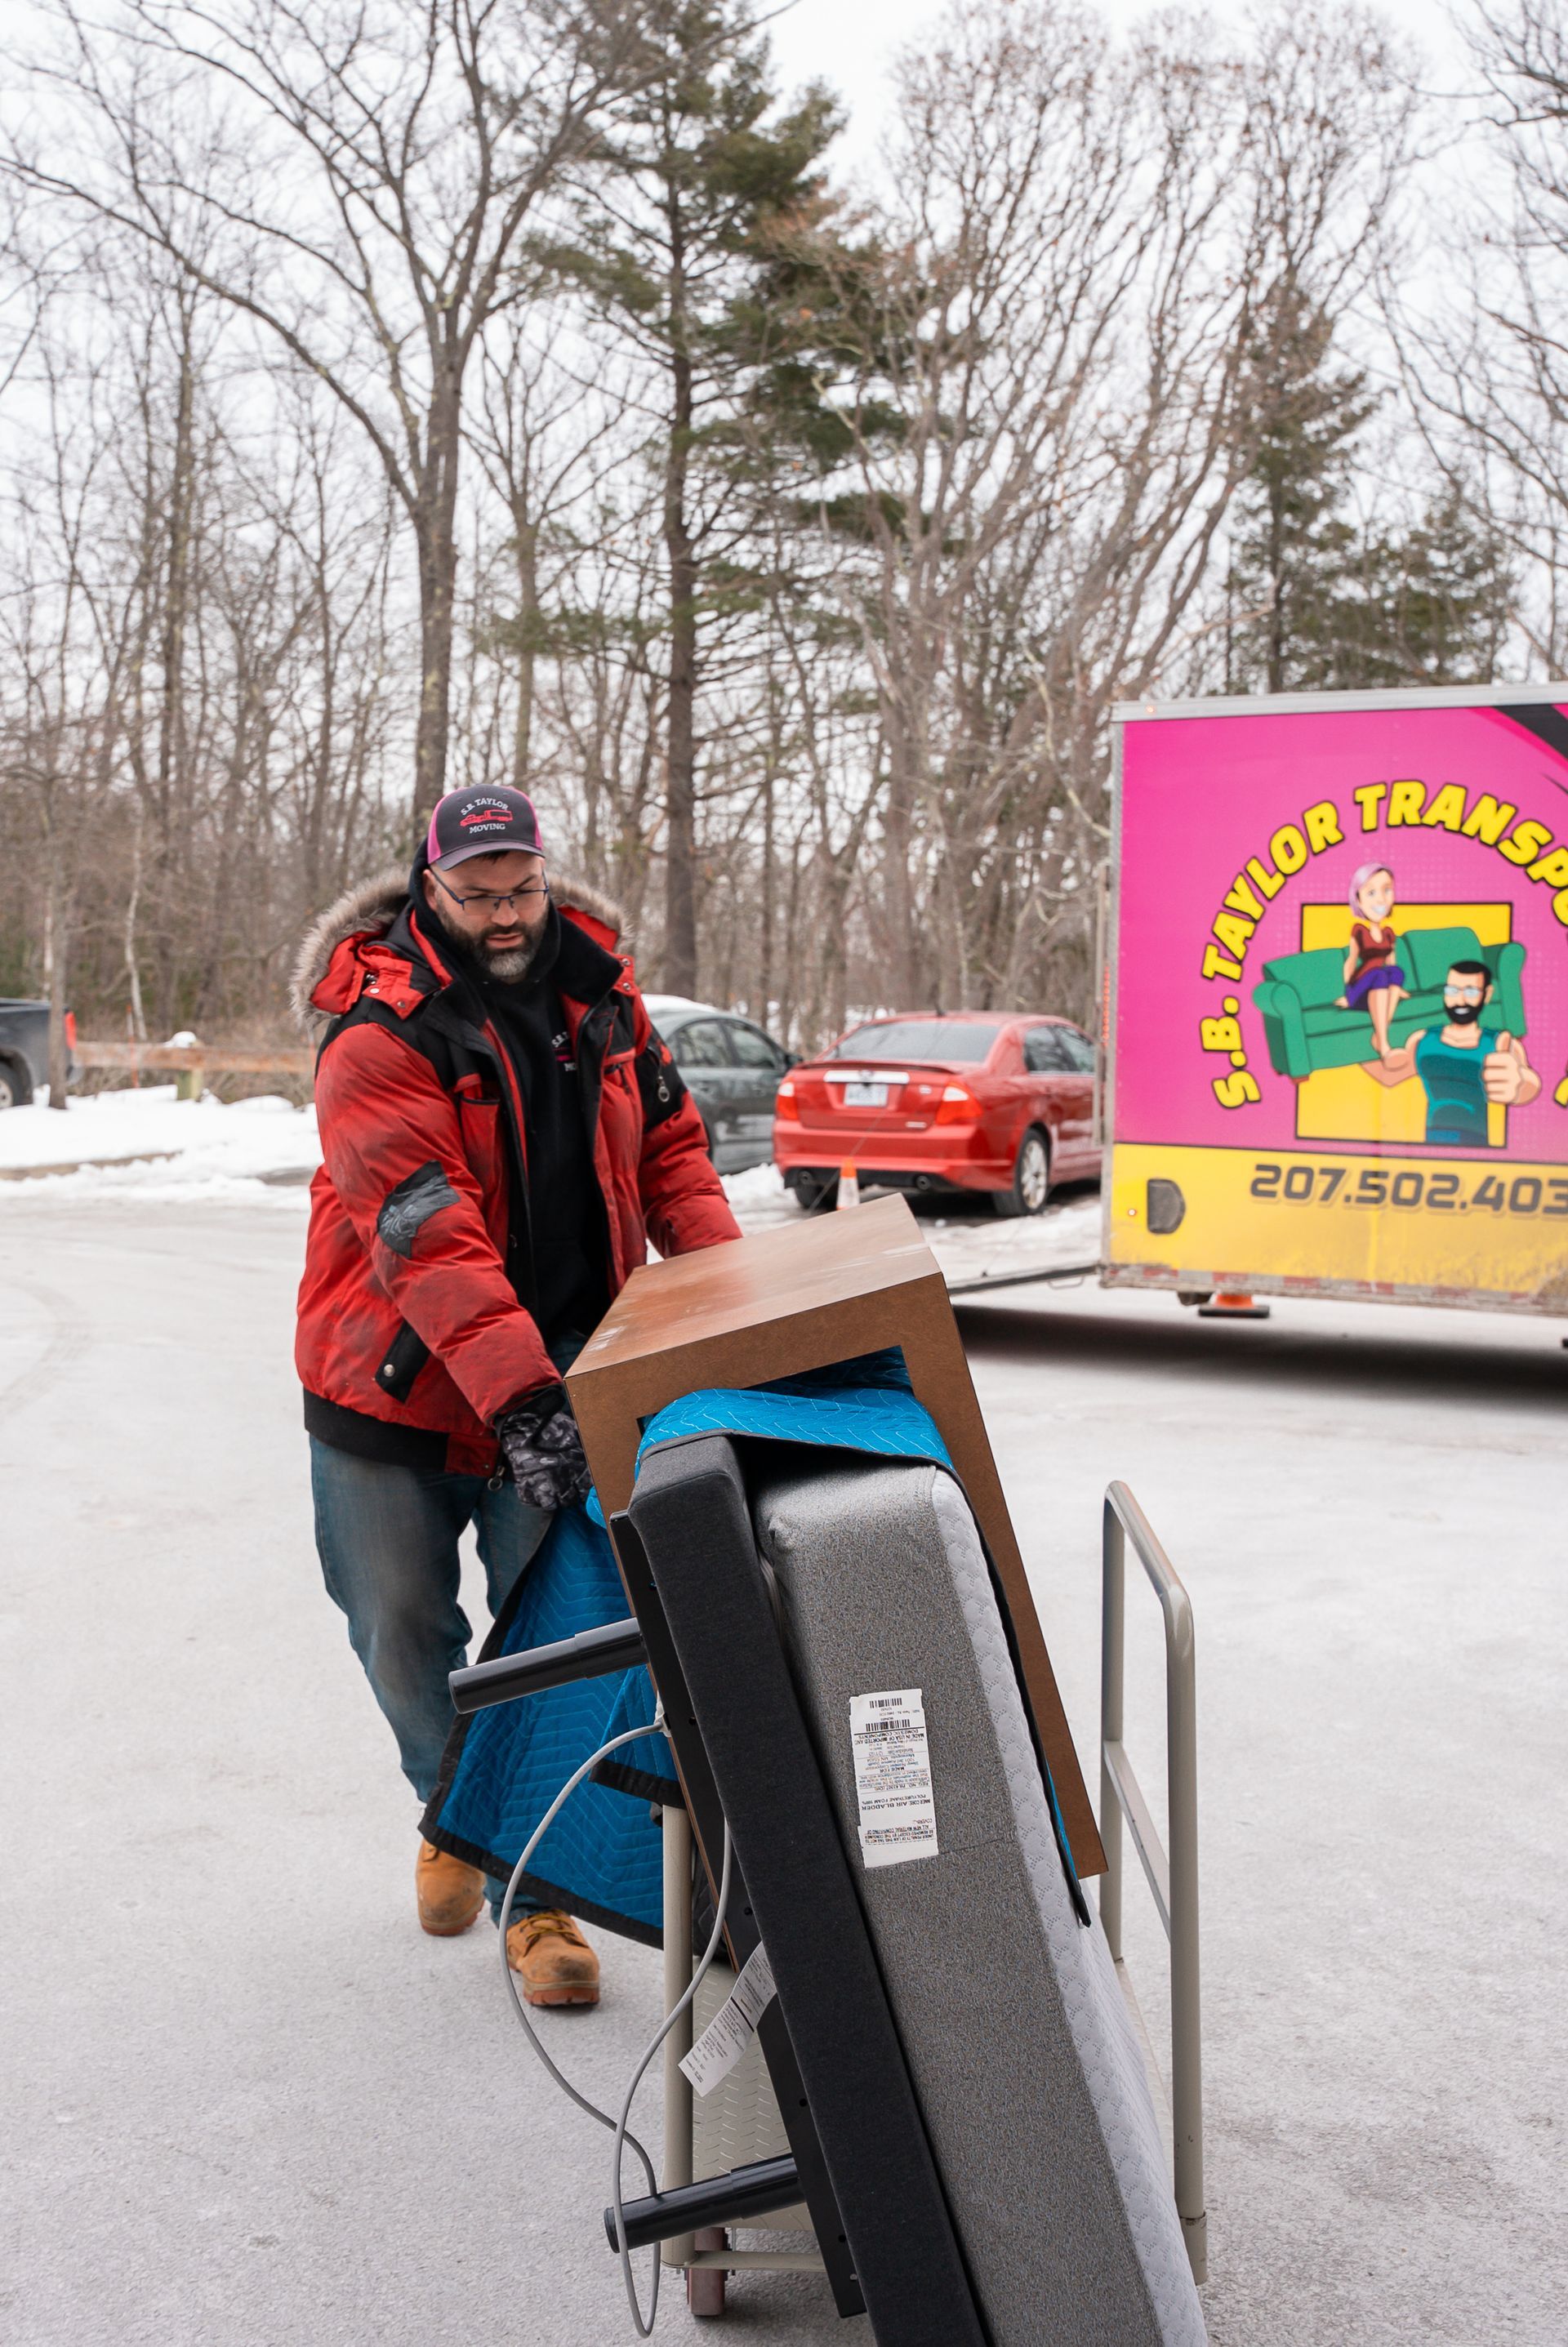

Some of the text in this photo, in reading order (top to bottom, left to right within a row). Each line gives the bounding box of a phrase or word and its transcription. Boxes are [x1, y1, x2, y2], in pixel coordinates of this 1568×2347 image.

[474, 797, 508, 811] TAYLOR
[469, 823, 506, 834] MOVING
[1201, 799, 1344, 982] TAYLOR
[1250, 1164, 1568, 1214] 207.502.403
